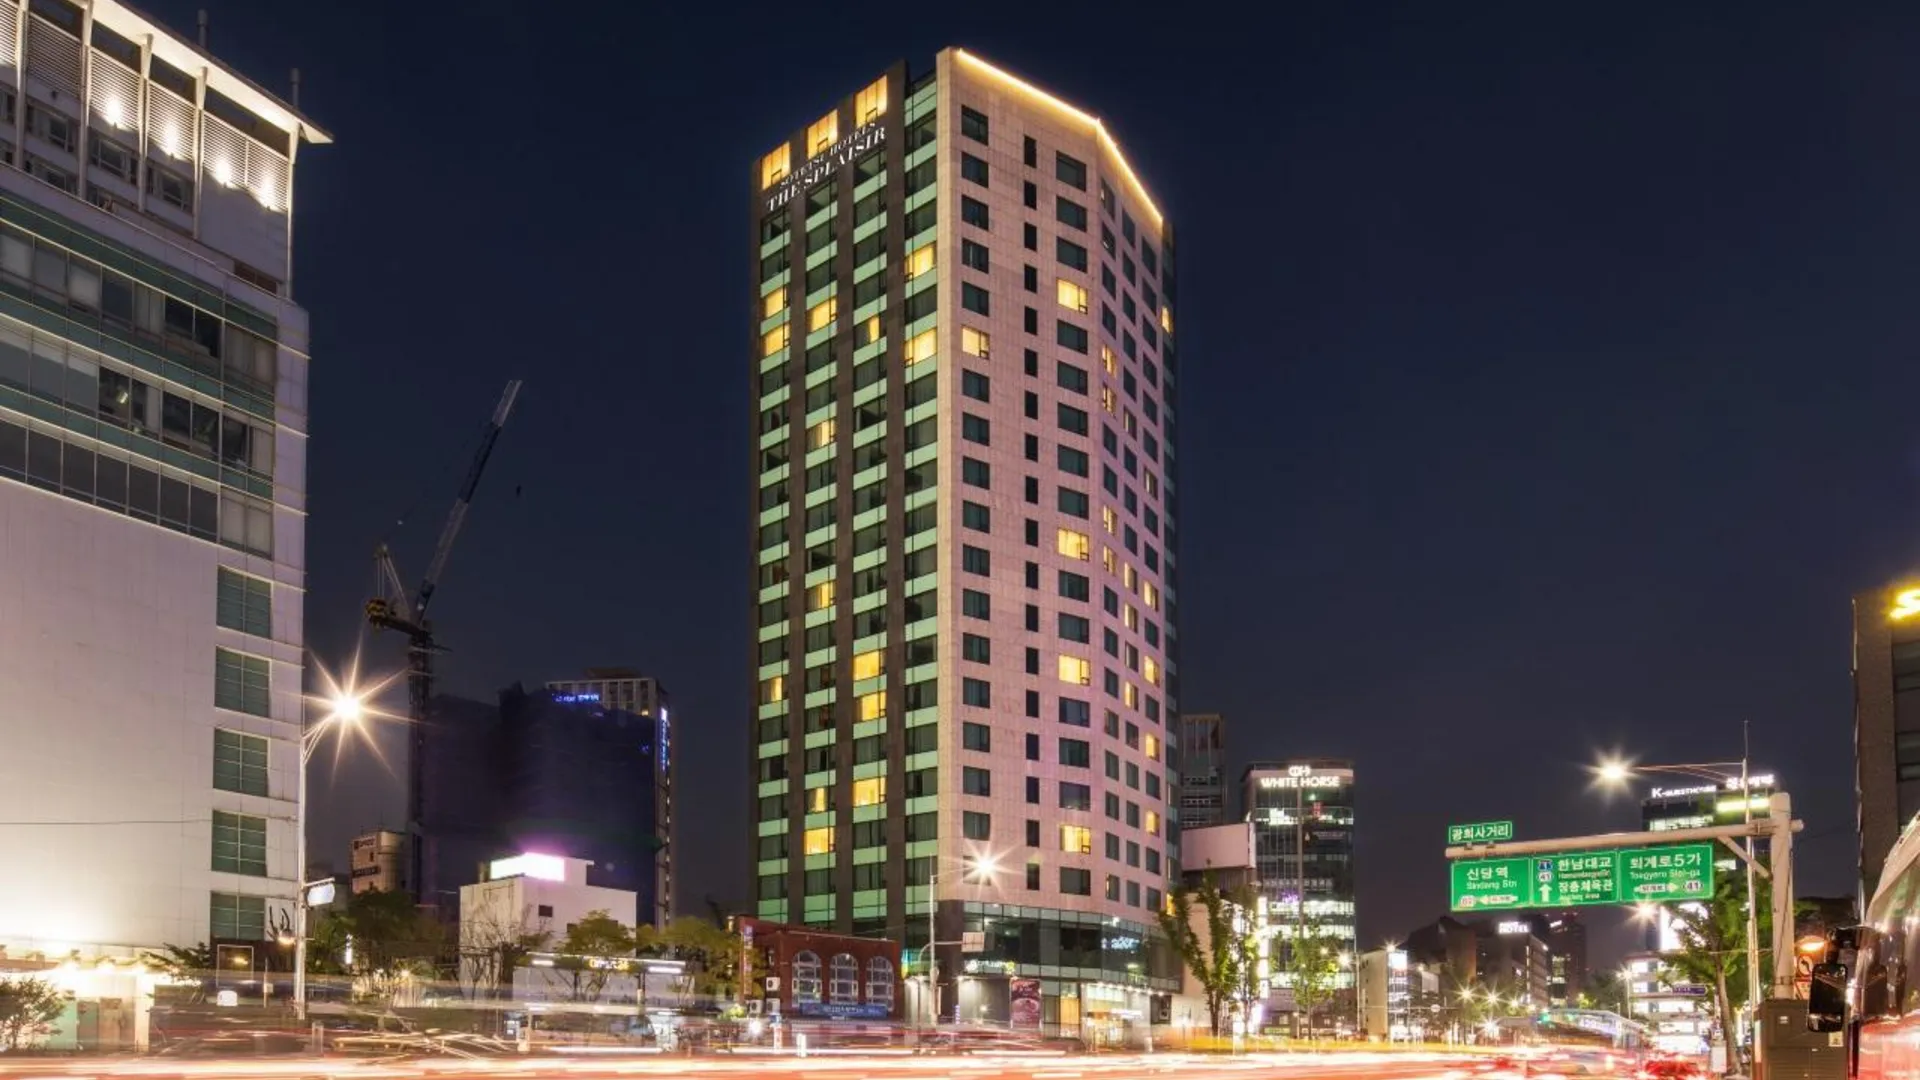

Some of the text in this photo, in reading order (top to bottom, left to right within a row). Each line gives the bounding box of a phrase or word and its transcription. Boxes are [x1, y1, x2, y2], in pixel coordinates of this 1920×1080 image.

[766, 126, 885, 212] THE SPLAISIR
[1261, 775, 1340, 788] WHITE HORSE
[1558, 856, 1613, 872] 한남대교
[1630, 852, 1702, 870] 퇴계로5가
